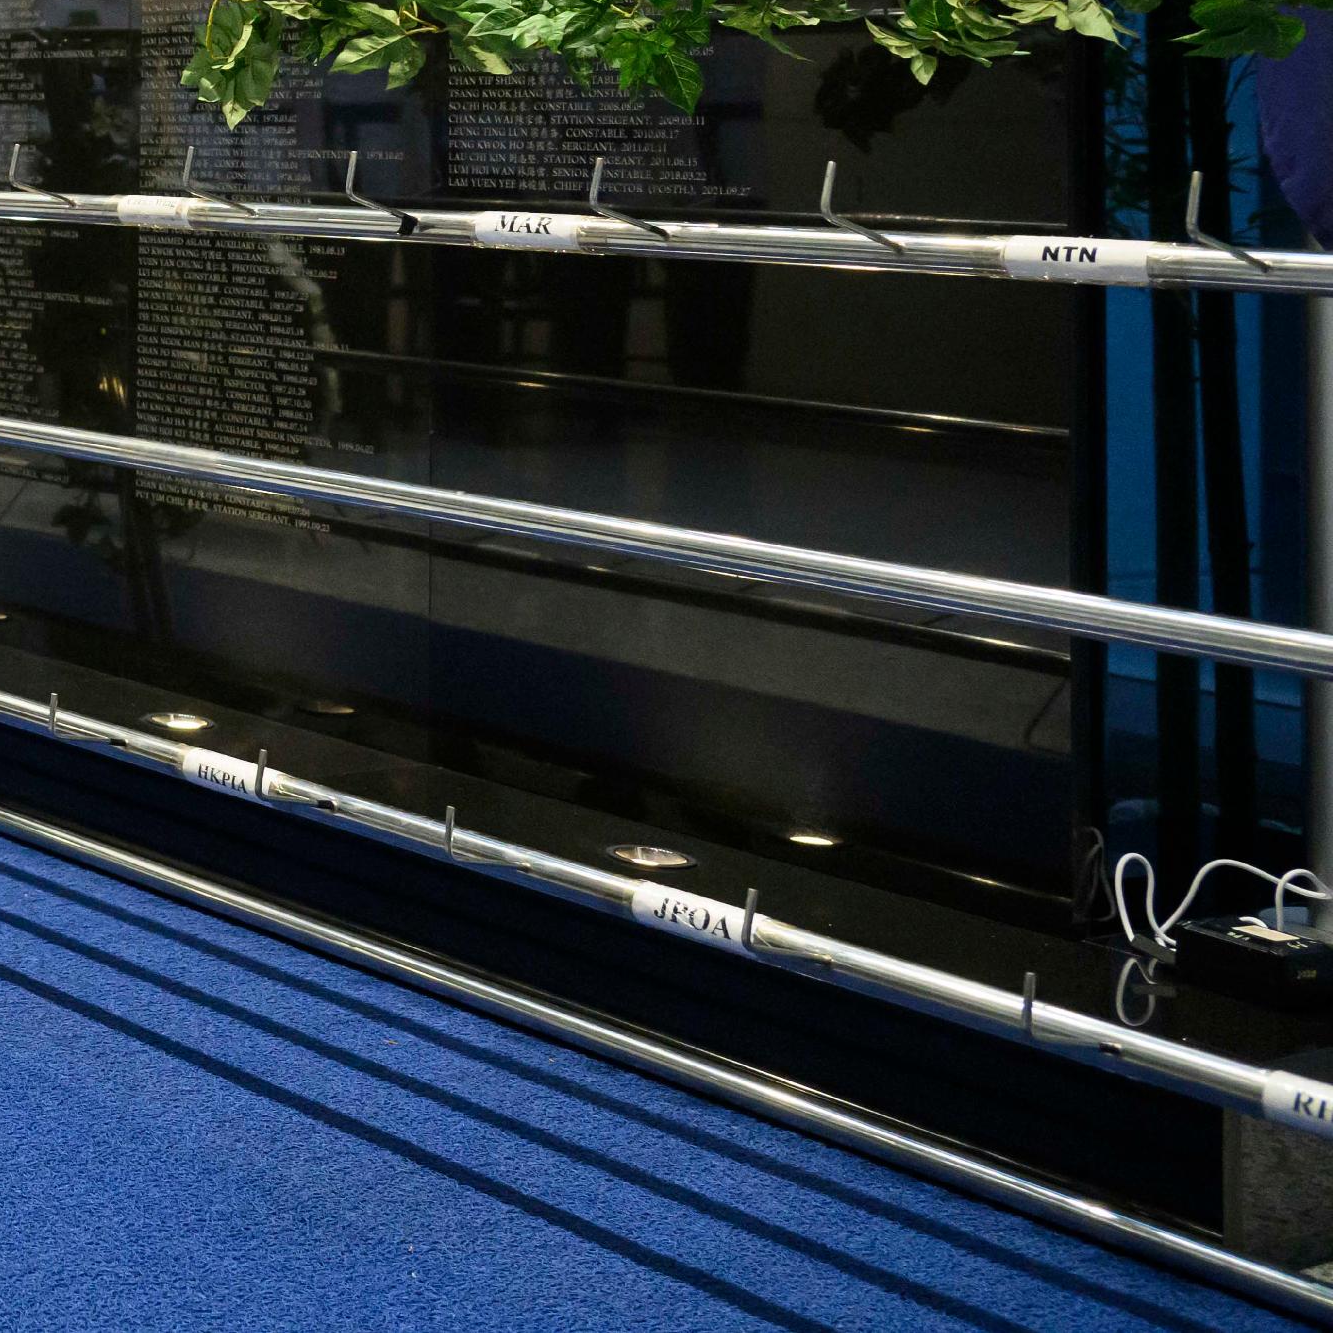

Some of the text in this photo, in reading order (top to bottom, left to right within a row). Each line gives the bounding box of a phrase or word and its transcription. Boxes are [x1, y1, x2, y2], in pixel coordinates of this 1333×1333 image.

[494, 215, 552, 235] MAR
[1041, 245, 1098, 263] NTN
[197, 763, 248, 795] HKPIA
[653, 897, 731, 940] JPOA
